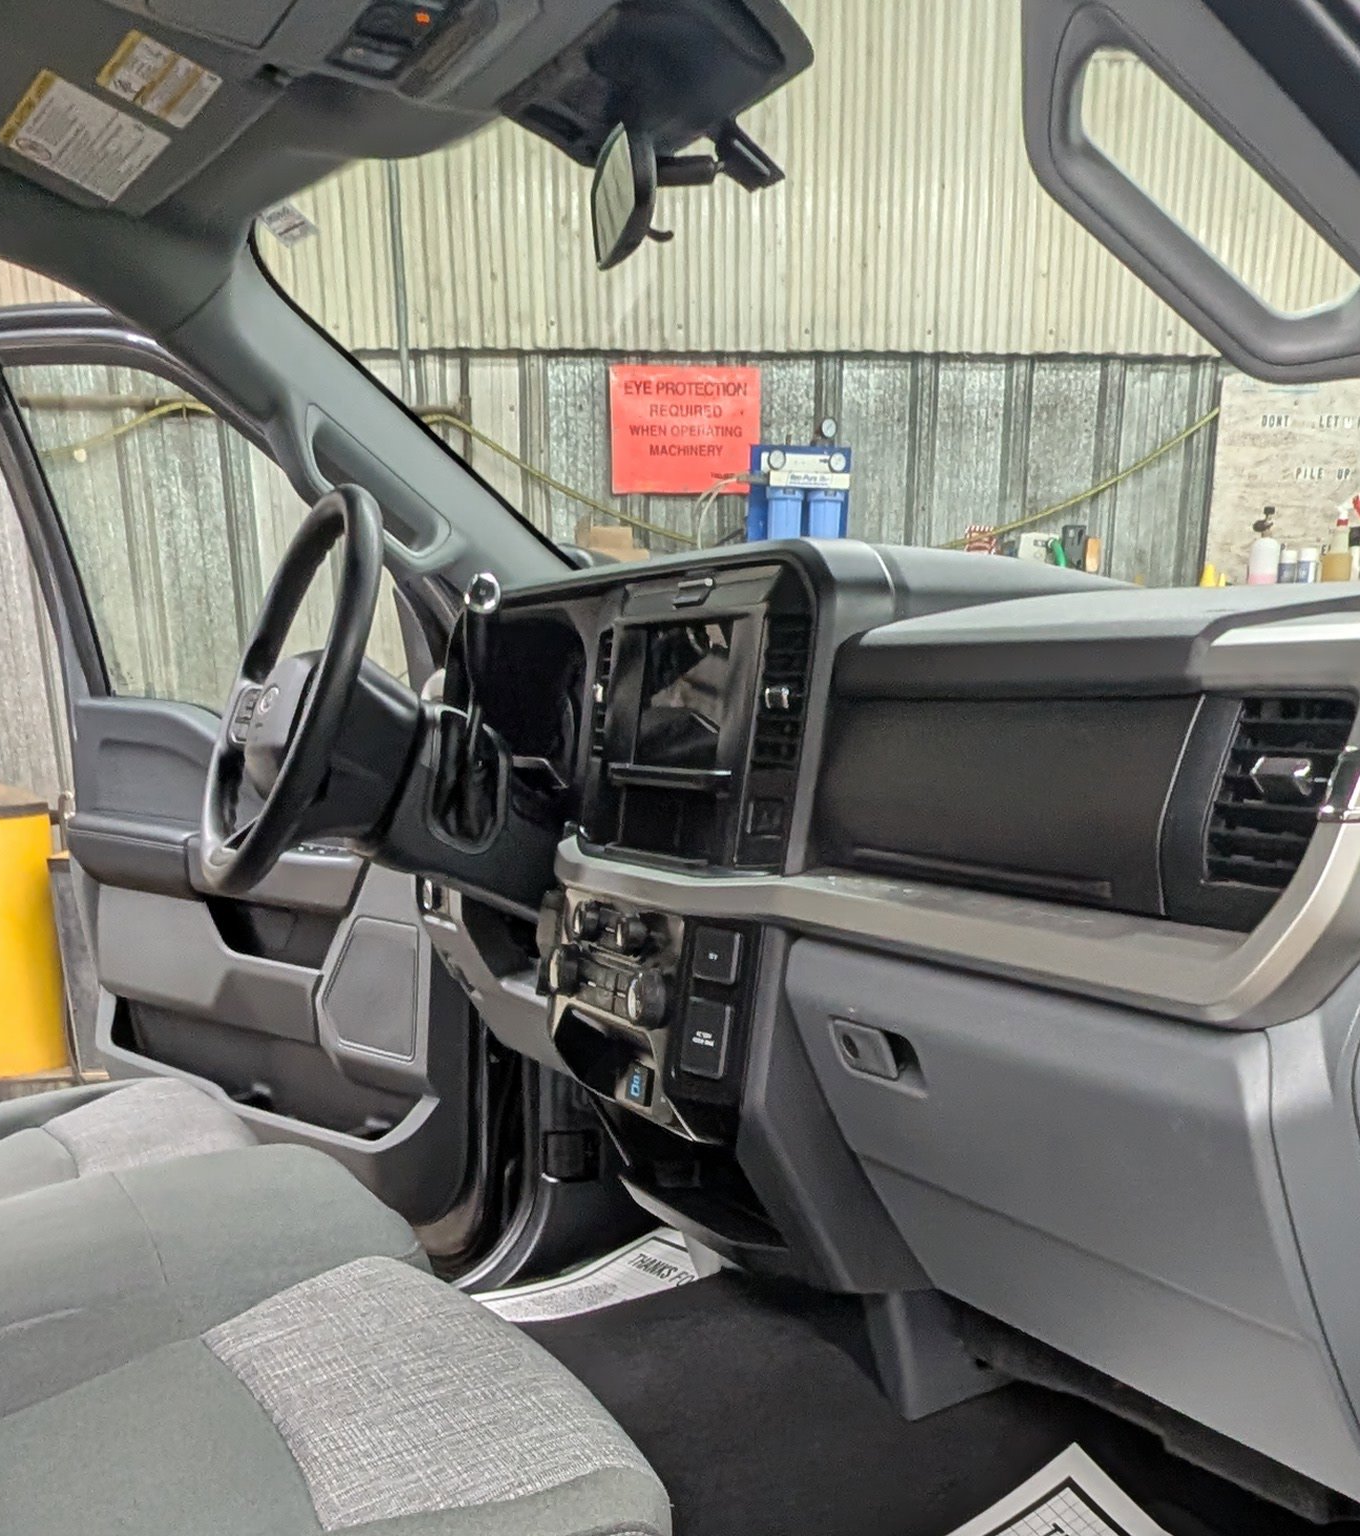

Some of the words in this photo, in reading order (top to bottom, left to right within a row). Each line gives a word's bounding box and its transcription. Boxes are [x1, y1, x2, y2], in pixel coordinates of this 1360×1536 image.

[624, 380, 652, 396] EYE
[656, 381, 747, 396] PROTECTION
[649, 404, 723, 418] REQUIRED
[1261, 414, 1290, 428] DONT
[1319, 415, 1339, 428] LET
[629, 424, 667, 437] WHEN
[670, 425, 743, 438] OPERATING
[649, 444, 724, 457] MACHINERY
[1295, 467, 1324, 480] PILE
[1337, 467, 1351, 480] UP
[628, 1253, 678, 1279] THANKS
